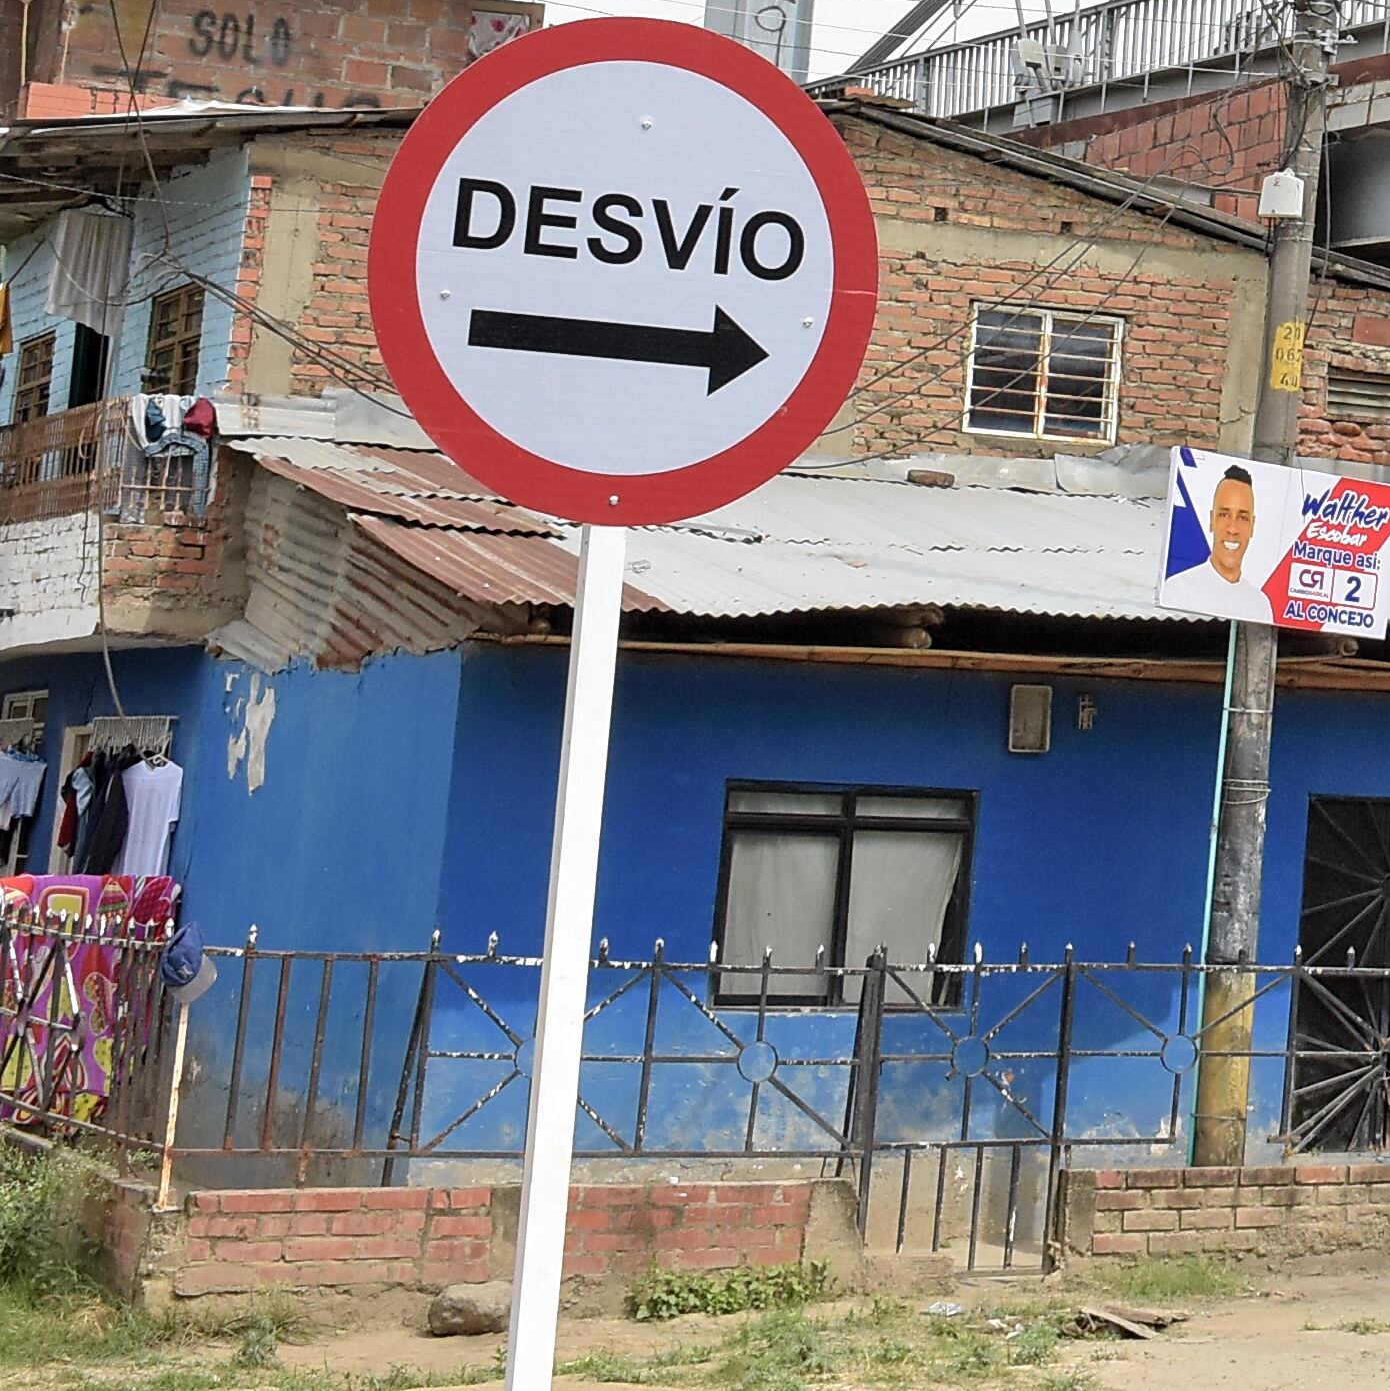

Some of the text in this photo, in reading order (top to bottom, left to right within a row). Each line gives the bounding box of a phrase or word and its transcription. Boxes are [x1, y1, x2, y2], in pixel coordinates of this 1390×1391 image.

[452, 177, 806, 282] DESVÍO
[1301, 488, 1389, 528] Walther
[1306, 521, 1368, 547] Escobar
[1293, 541, 1352, 567] Marque
[1344, 575, 1362, 603] 2
[1285, 600, 1375, 629] AL CONCEJO
